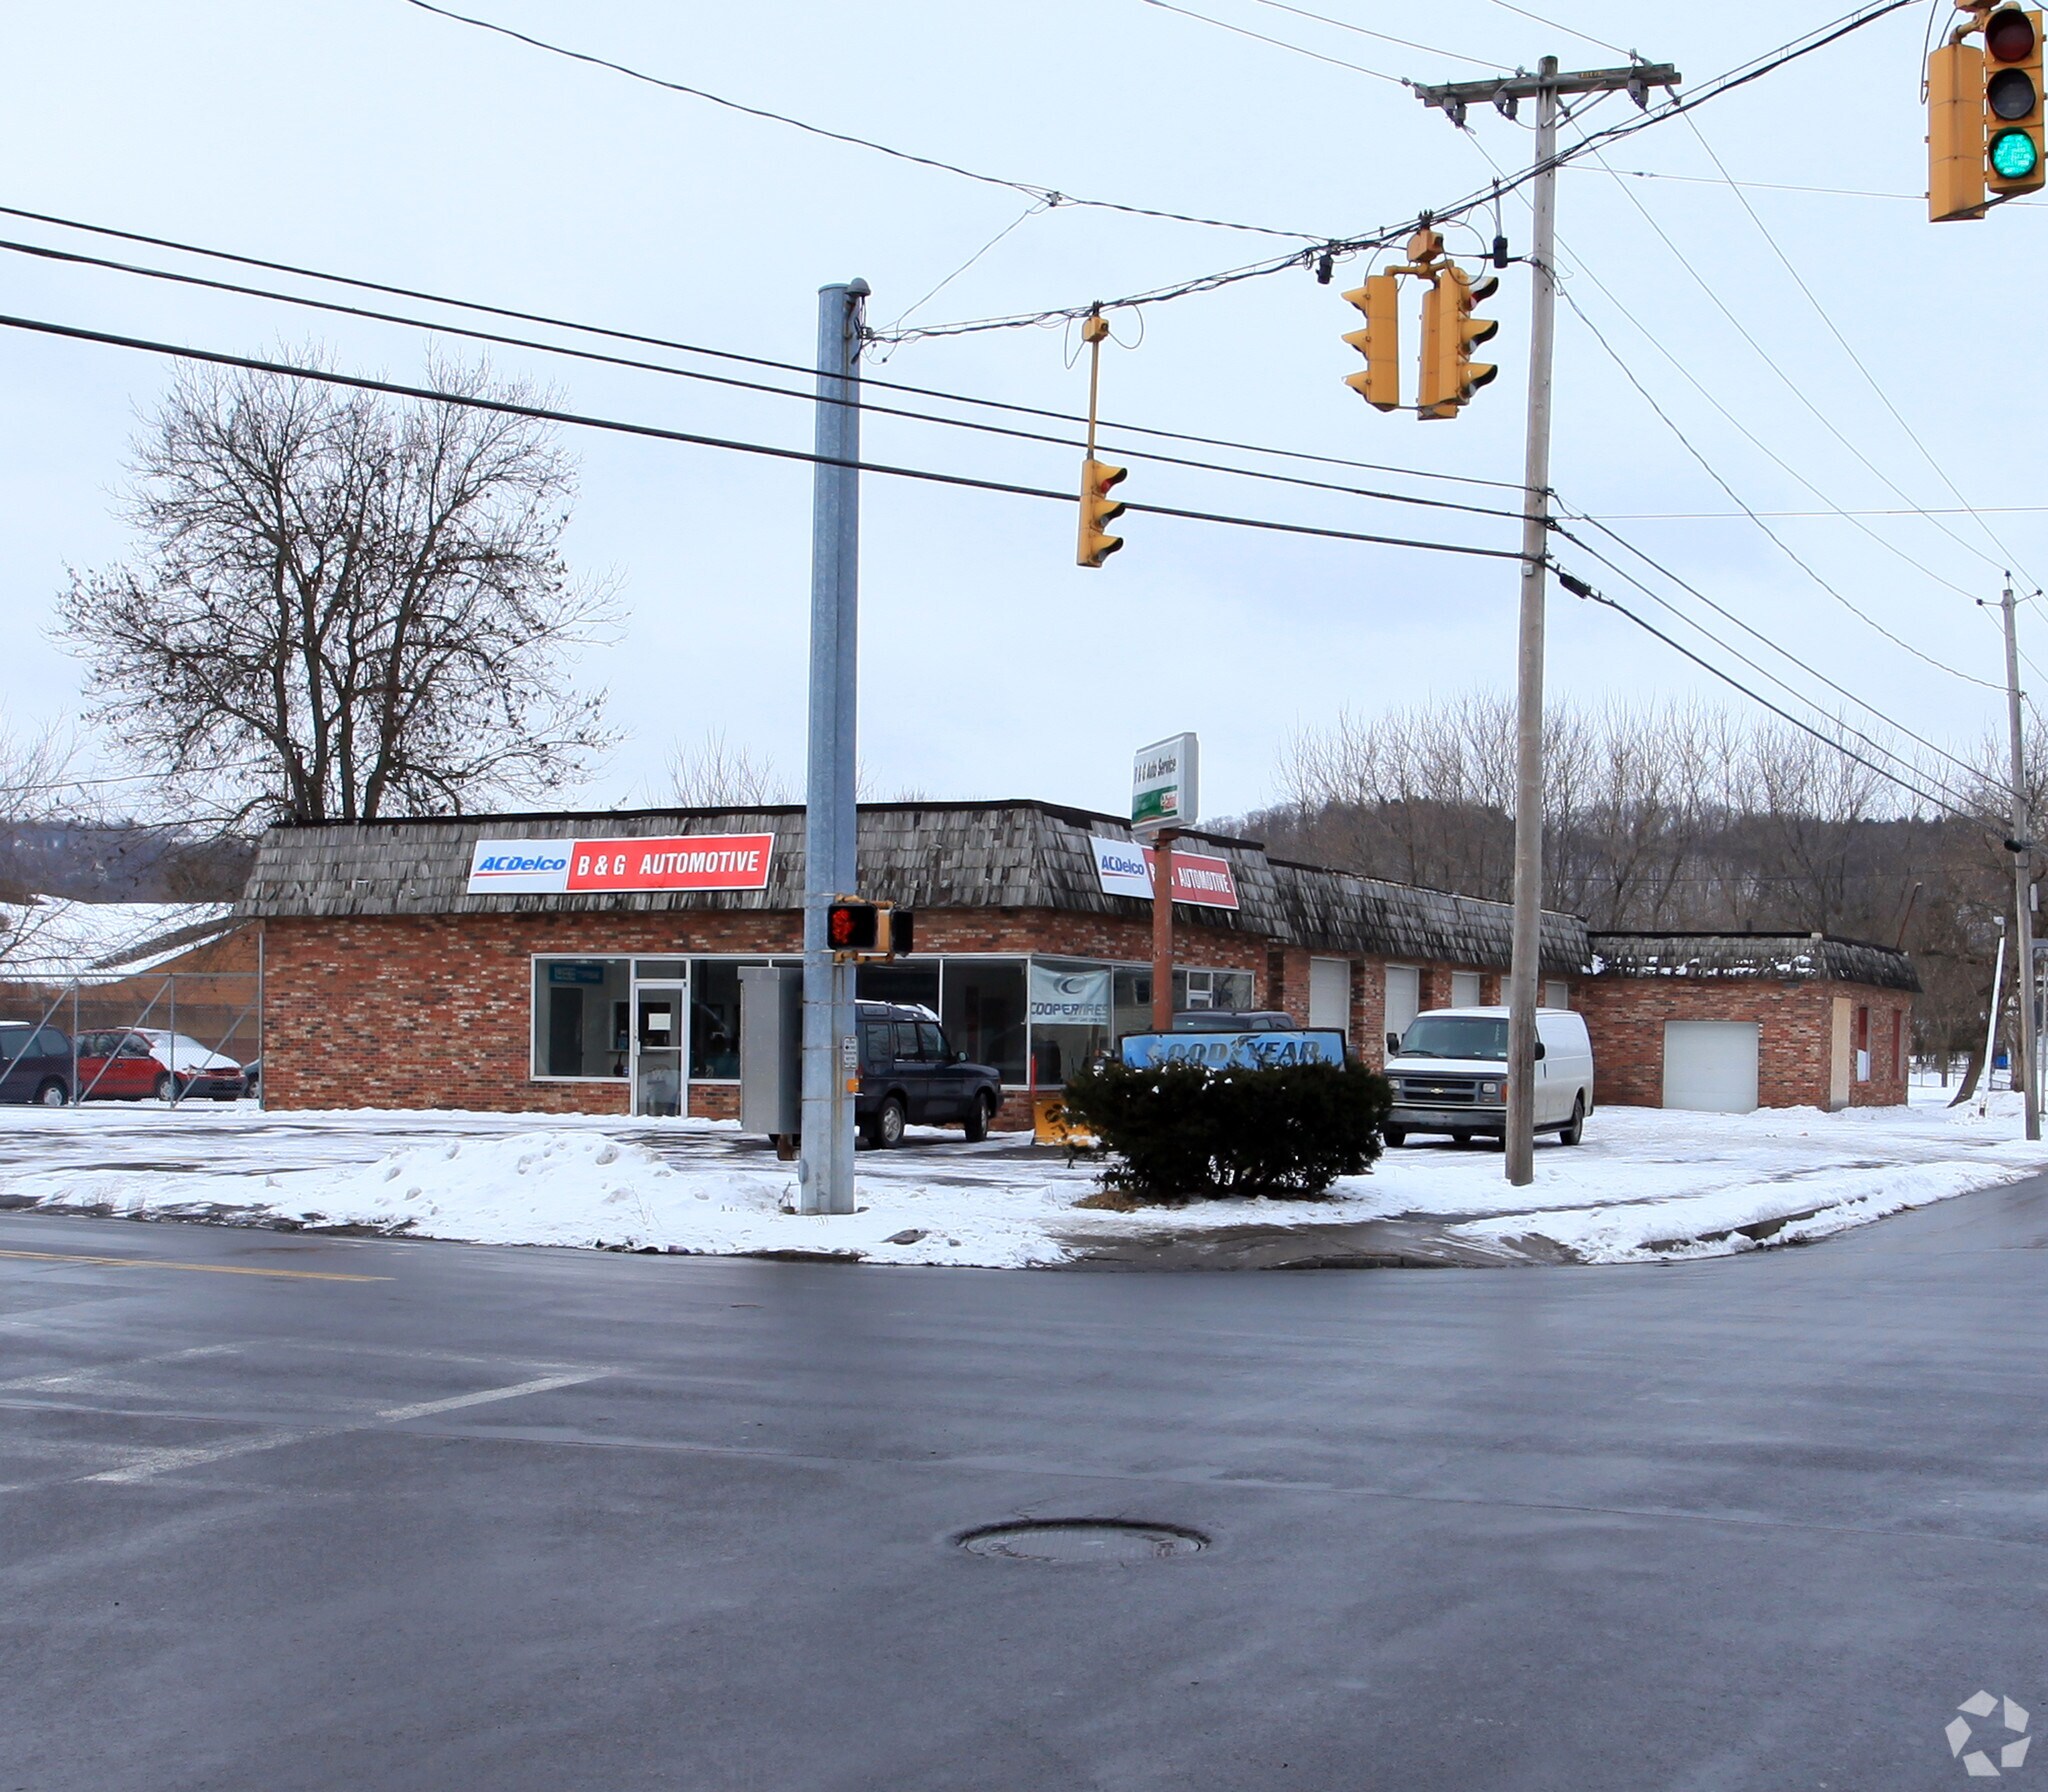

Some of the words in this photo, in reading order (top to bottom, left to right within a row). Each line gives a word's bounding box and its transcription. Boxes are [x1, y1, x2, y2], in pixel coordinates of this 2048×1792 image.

[478, 855, 566, 872] ACDelco
[577, 856, 589, 876] B
[594, 856, 608, 875] &
[613, 854, 626, 875] G
[639, 850, 760, 875] AUTOMOTIVE
[1101, 855, 1145, 875] ACDelco
[1178, 867, 1230, 893] AUTOMOTIVE
